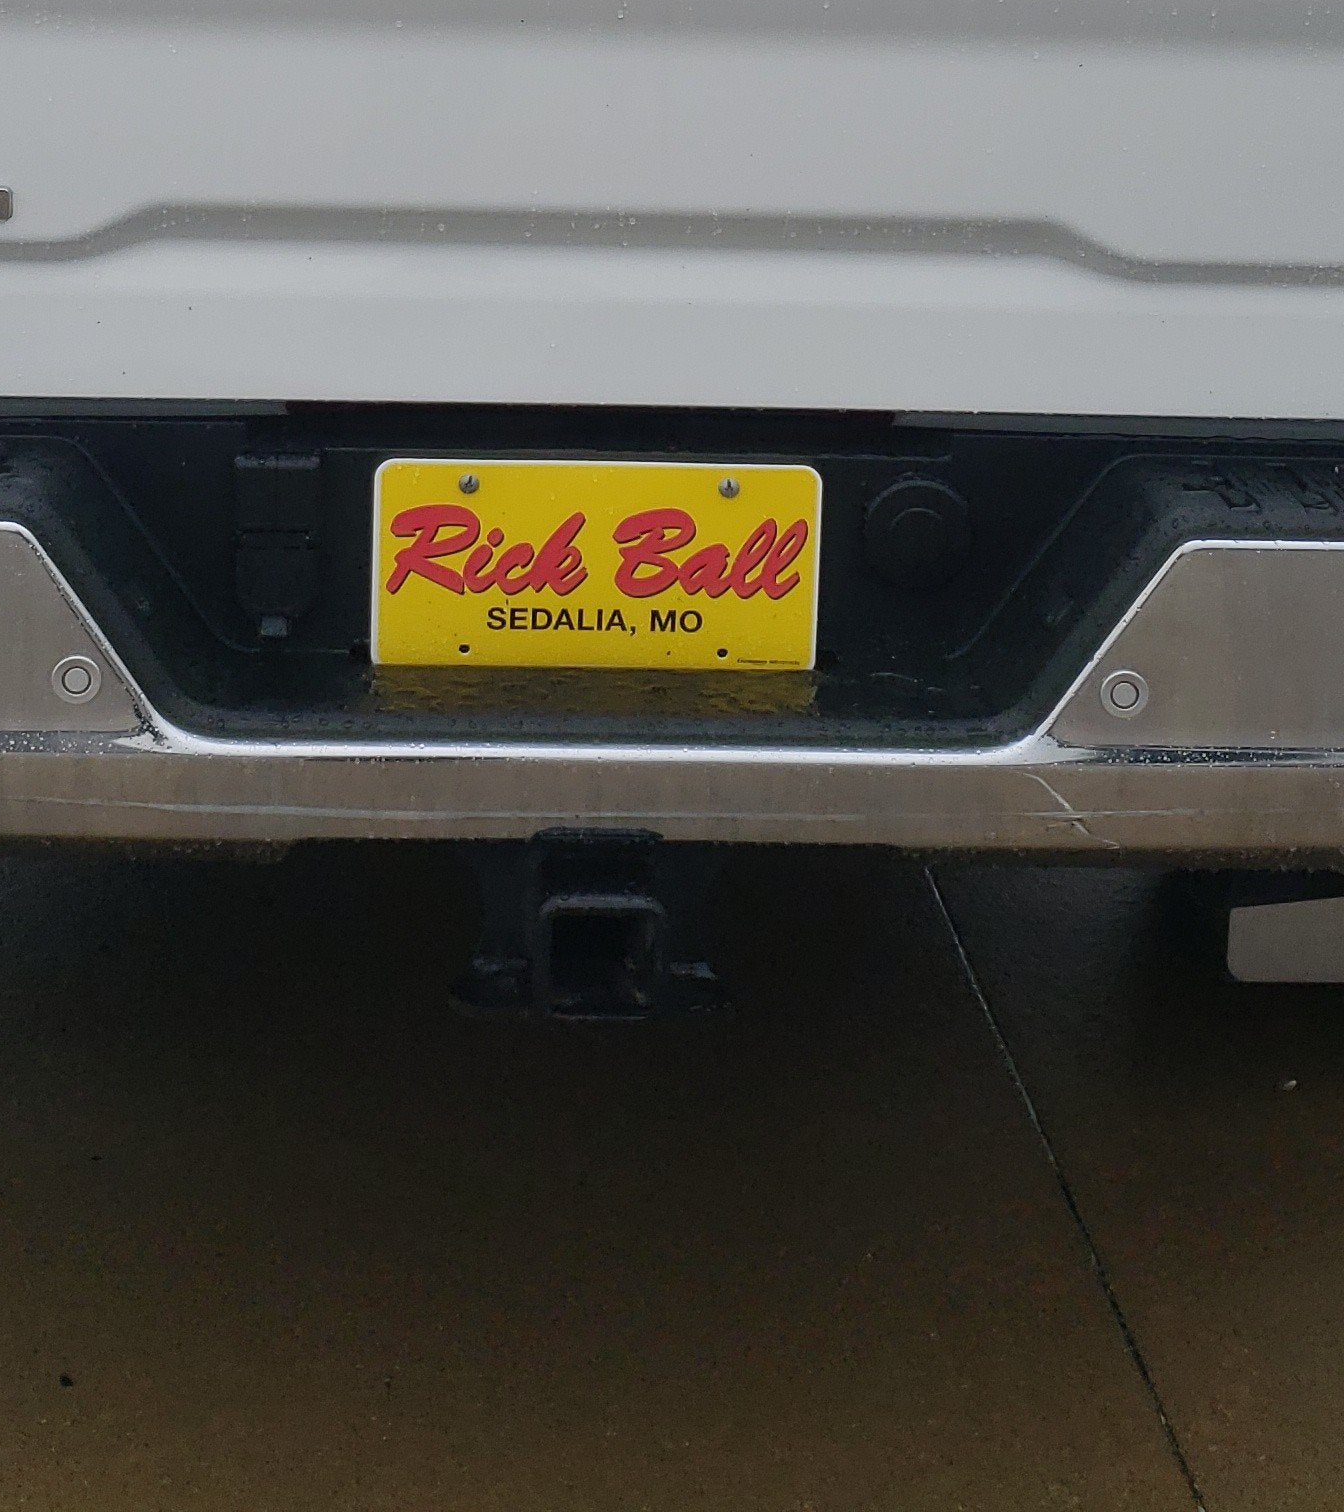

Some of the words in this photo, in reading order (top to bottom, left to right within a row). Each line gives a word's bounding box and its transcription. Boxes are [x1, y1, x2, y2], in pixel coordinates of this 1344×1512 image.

[385, 503, 589, 596] Rick
[612, 507, 809, 600] Ball
[485, 606, 638, 637] SEDALIA,
[649, 608, 704, 634] MO
